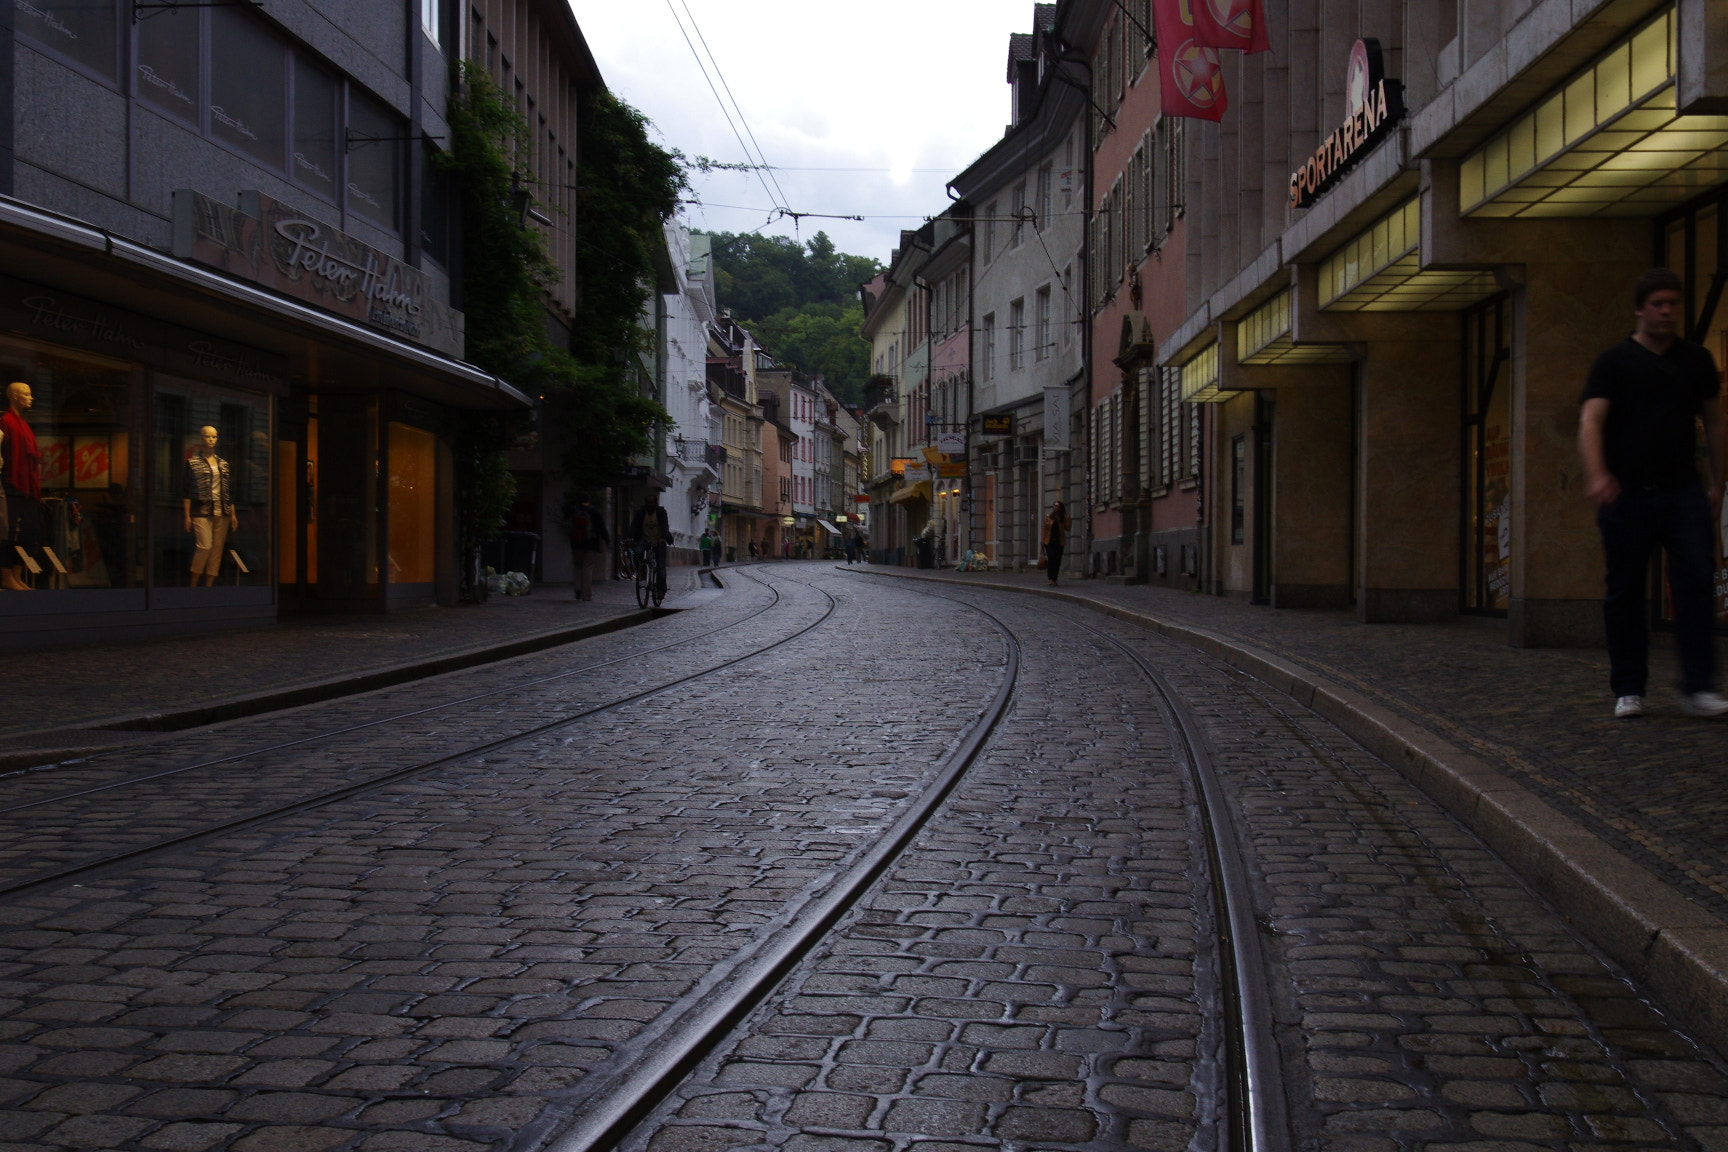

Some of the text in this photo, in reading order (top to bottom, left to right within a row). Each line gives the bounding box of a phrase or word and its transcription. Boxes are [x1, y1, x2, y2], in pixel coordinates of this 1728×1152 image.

[1290, 79, 1388, 208] SPORTARENA
[274, 219, 421, 321] Peter Hahn
[22, 296, 145, 349] Peter Hahn
[188, 341, 276, 382] Peter Hahn
